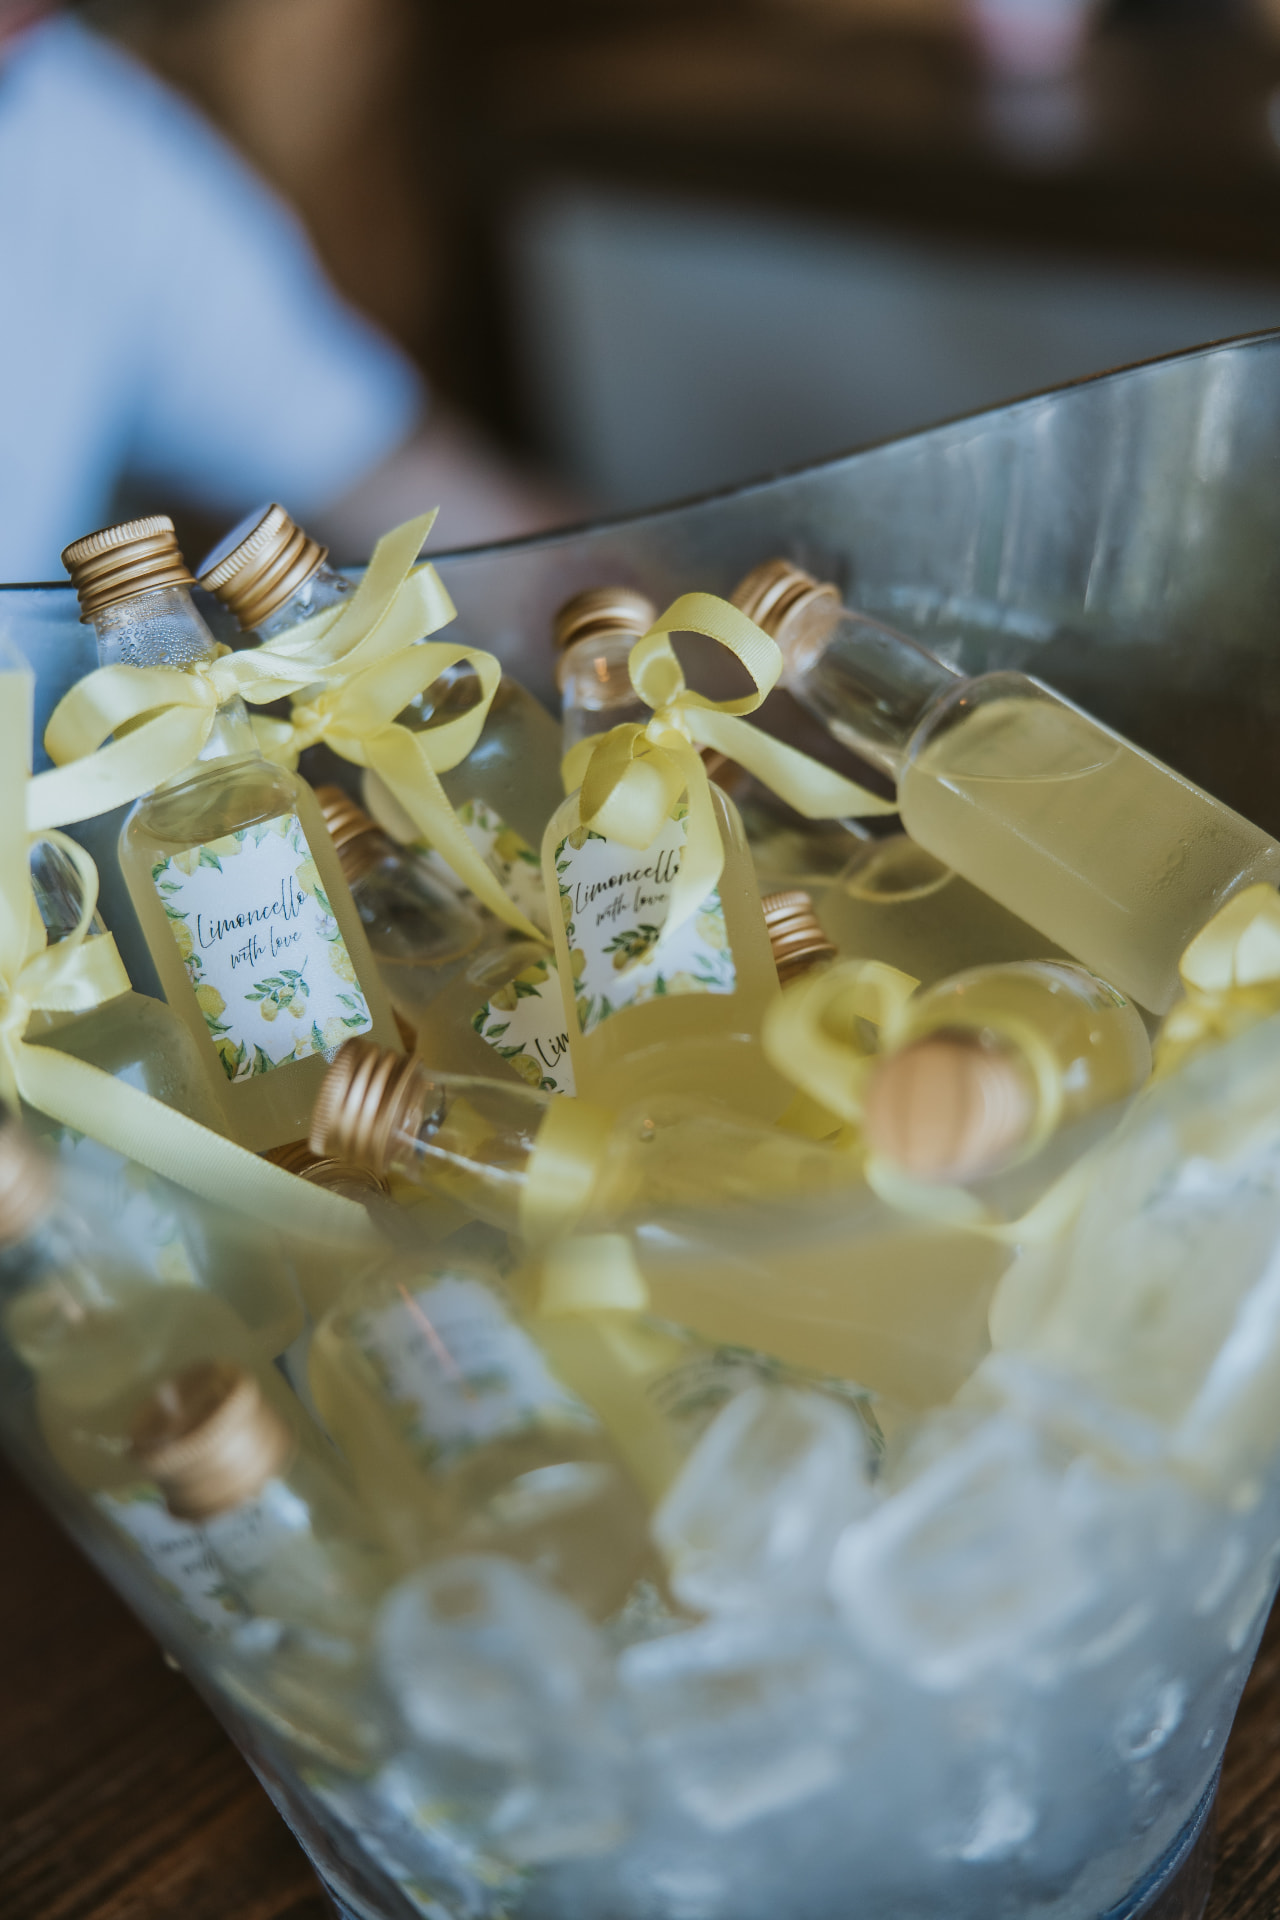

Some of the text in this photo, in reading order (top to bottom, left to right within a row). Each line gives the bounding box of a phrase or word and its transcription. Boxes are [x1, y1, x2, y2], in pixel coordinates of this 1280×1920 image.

[197, 876, 308, 949] Limoncello
[596, 886, 668, 926] with love
[230, 926, 301, 968] with love
